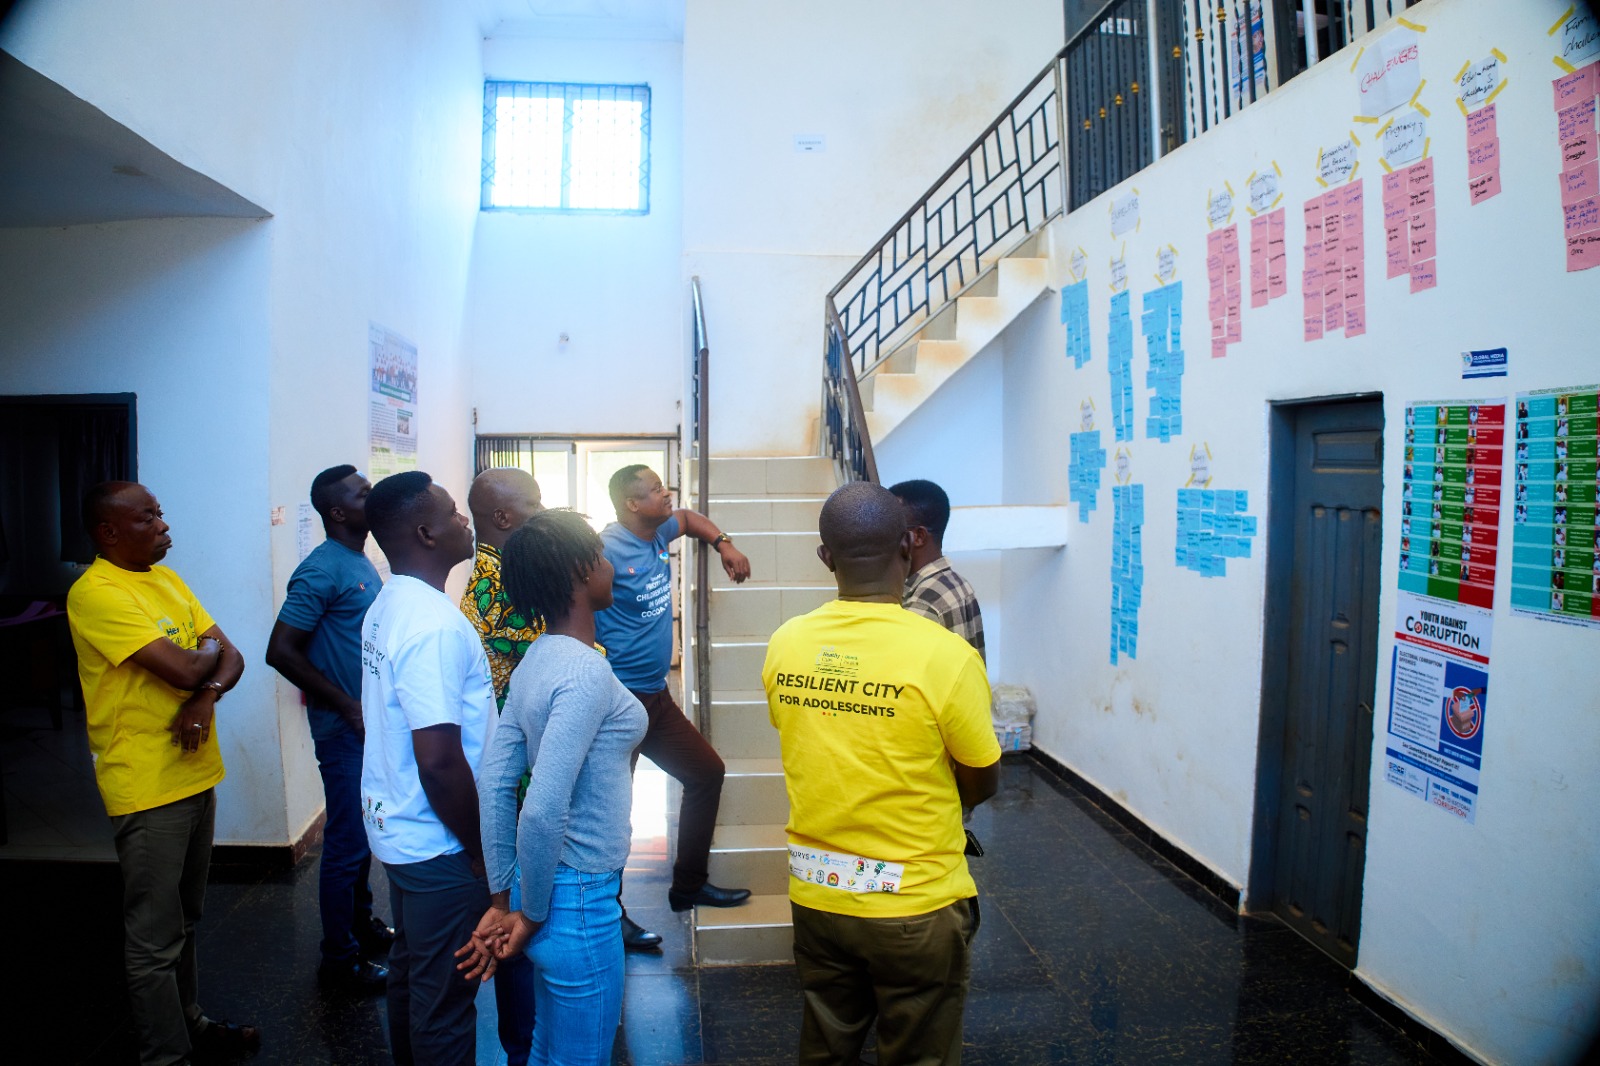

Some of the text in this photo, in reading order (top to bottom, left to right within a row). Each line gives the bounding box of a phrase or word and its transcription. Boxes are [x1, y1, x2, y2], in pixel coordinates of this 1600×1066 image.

[1405, 615, 1480, 650] CORRUPTION
[1420, 610, 1468, 631] YOUTH AGAINST
[776, 672, 905, 700] RESILIENT CITY
[778, 694, 896, 718] FOR ADOLESCENTS
